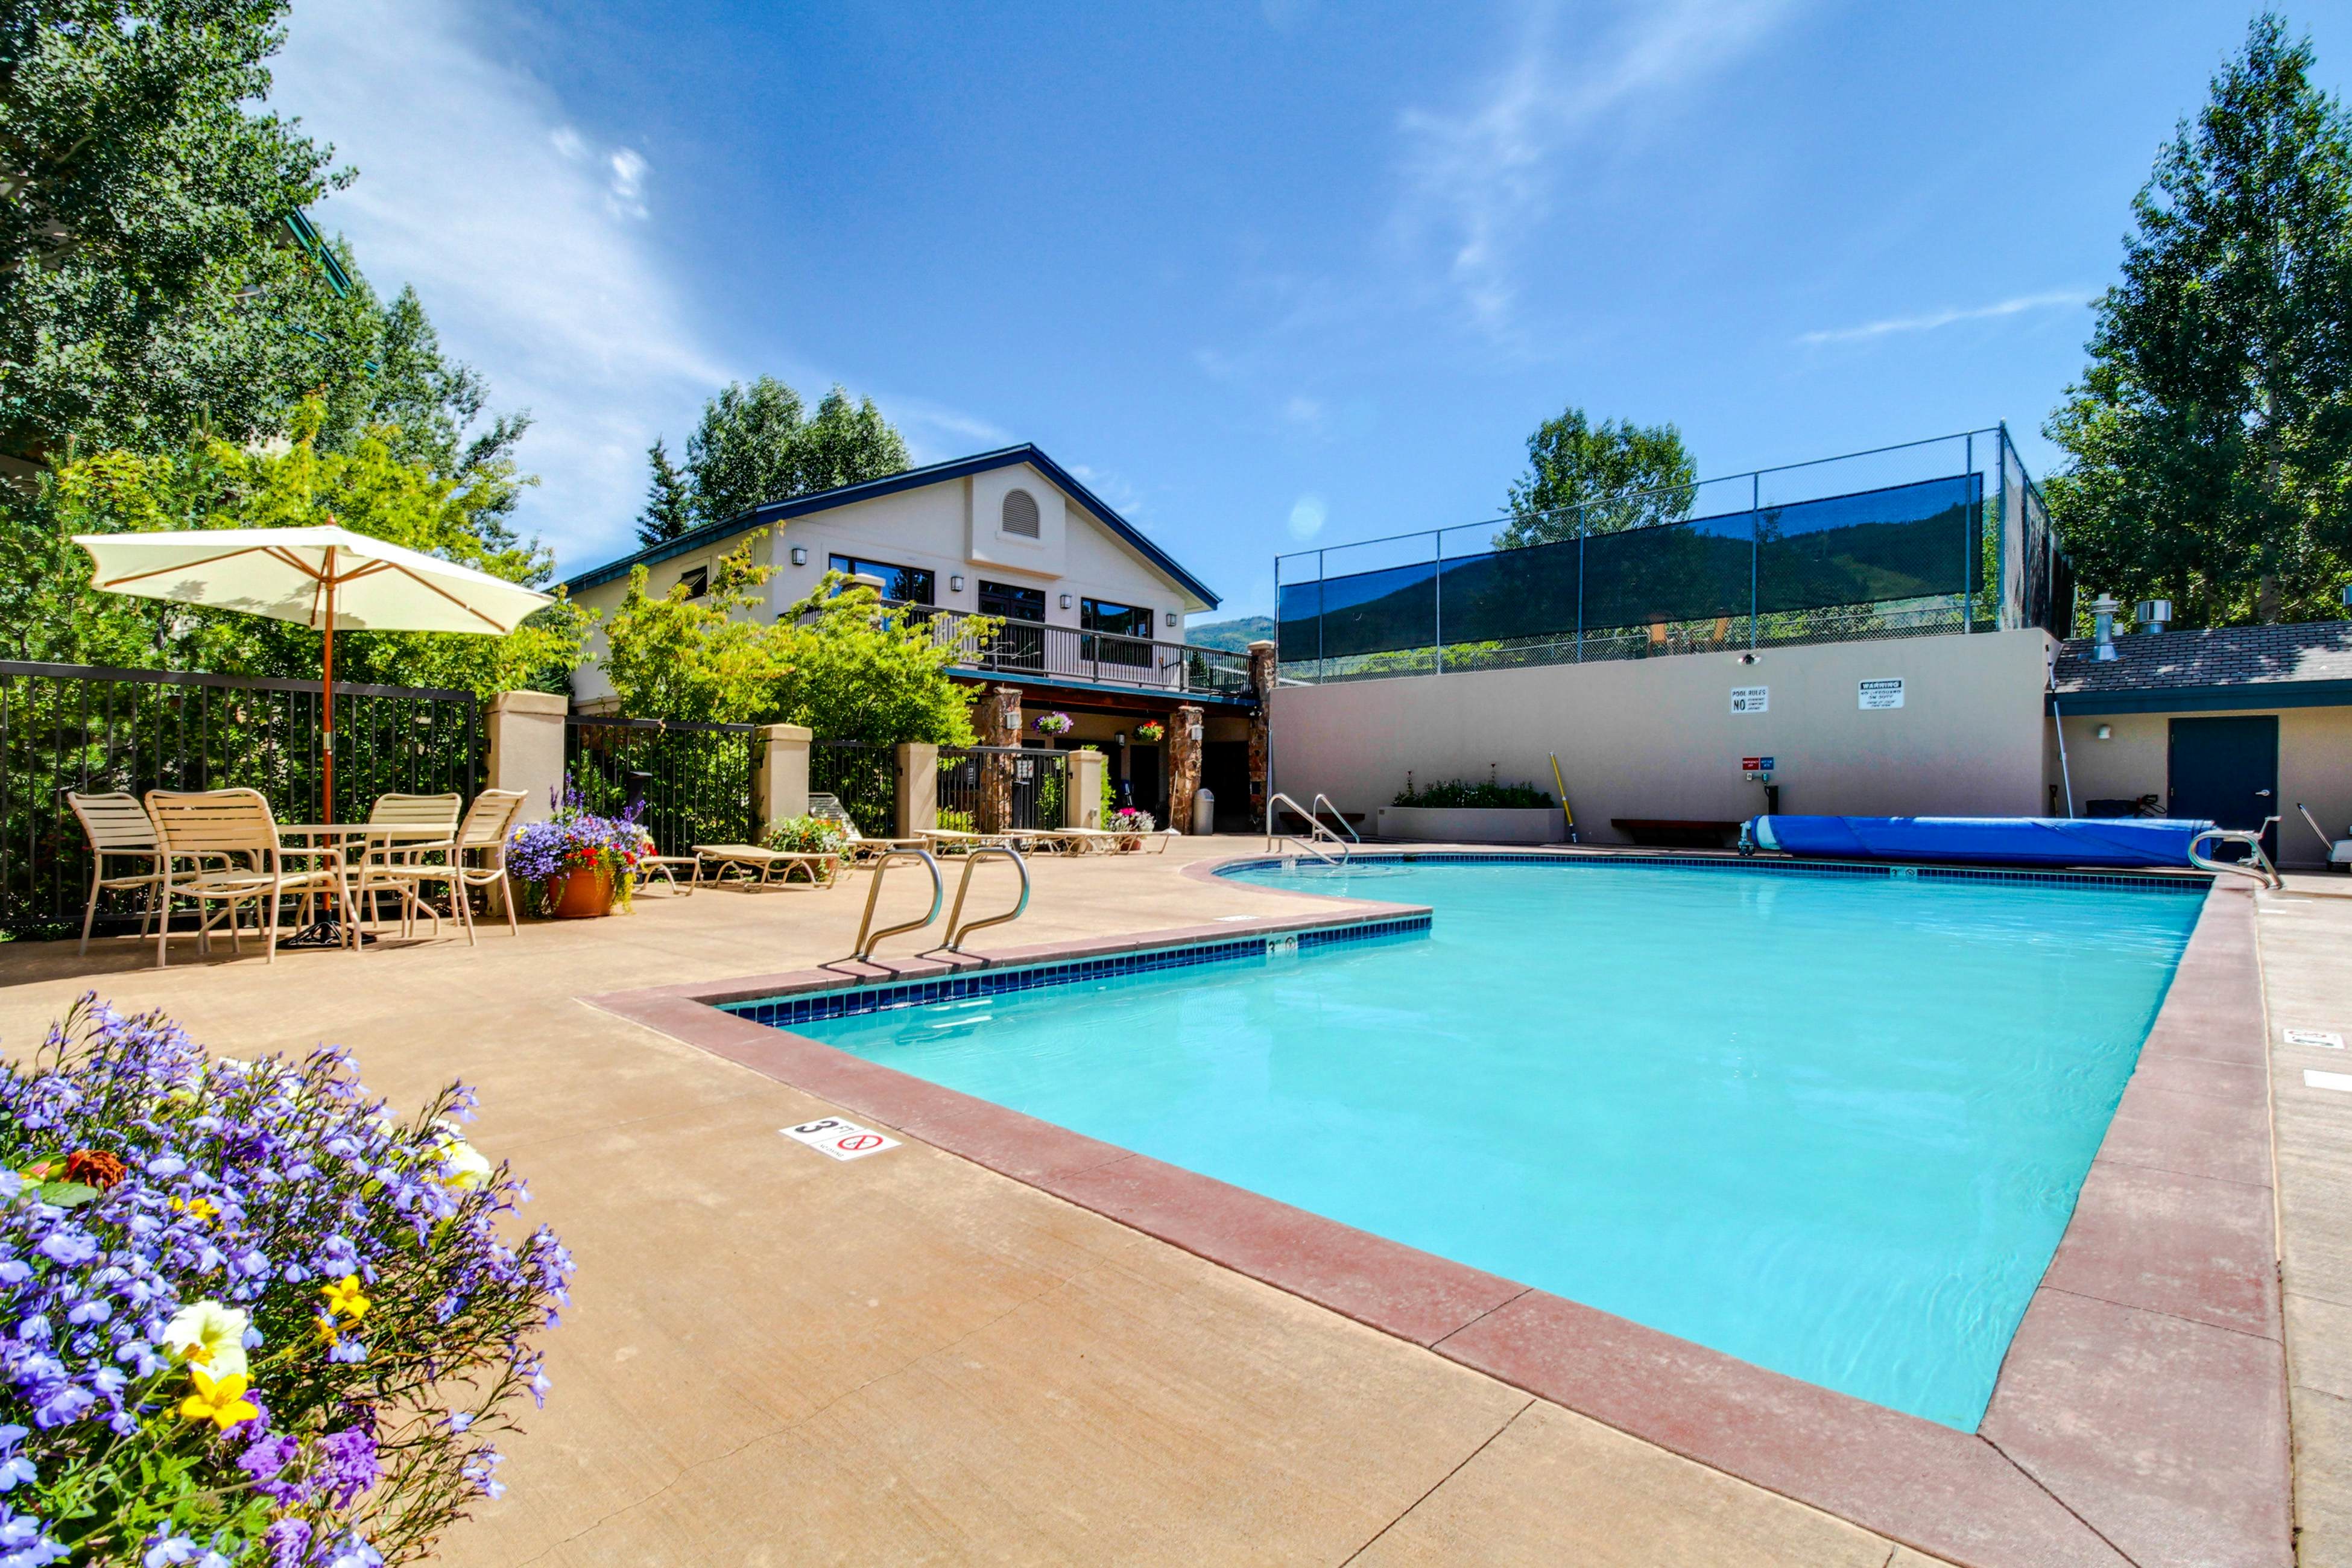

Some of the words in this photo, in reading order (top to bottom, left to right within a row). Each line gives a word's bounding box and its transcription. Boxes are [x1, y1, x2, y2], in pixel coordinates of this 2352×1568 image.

[1733, 699, 1745, 710] NO
[794, 1121, 839, 1133] 3
[833, 1125, 855, 1133] FT
